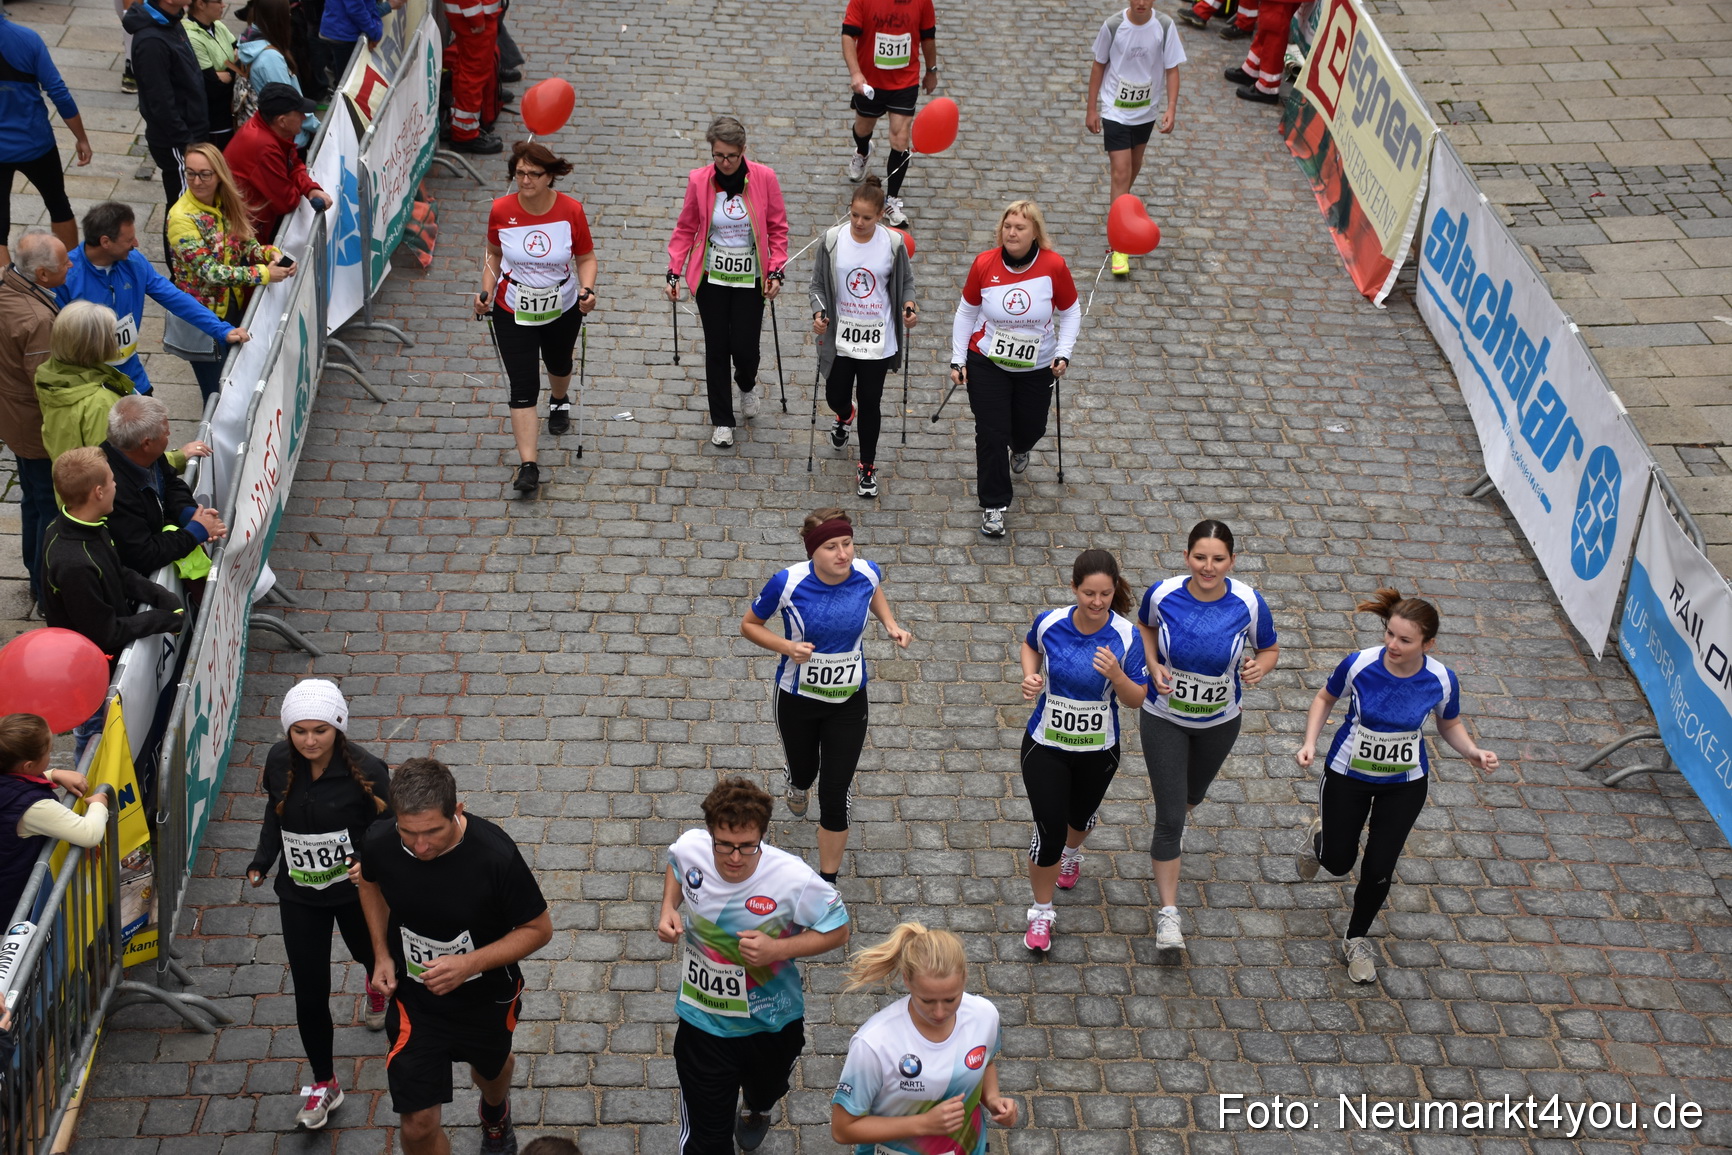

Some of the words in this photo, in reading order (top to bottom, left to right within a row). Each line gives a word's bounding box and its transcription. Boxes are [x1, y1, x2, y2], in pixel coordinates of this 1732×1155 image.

[878, 42, 908, 56] 5311
[1119, 87, 1151, 101] 5131
[714, 255, 752, 273] 5050
[720, 273, 744, 283] Carmen
[520, 294, 559, 313] 5177
[841, 327, 881, 345] 4048
[851, 346, 868, 355] Anna
[994, 339, 1036, 360] 5140
[1624, 594, 1650, 634] AUF
[1645, 630, 1675, 690] JEDER
[806, 657, 825, 666] ARTL
[824, 656, 853, 666] Neumarkt
[806, 663, 857, 685] 5027
[1171, 670, 1193, 682] PARTL
[1193, 676, 1224, 687] Neumarkt
[812, 686, 848, 698] Christine
[1174, 680, 1228, 703] 5142
[1047, 698, 1068, 710] PARTL
[1067, 702, 1099, 712] Neumarkt
[1184, 704, 1214, 714] Sophie
[1051, 708, 1104, 732] 5059
[1056, 733, 1094, 745] Franziska
[1357, 729, 1378, 742] PARTL
[1378, 735, 1410, 744] Neumarkt
[1359, 739, 1413, 763] 5046
[1371, 763, 1396, 774] Sonja
[283, 835, 303, 847] PARTL
[302, 838, 338, 848] Neumarkt
[290, 844, 348, 869] 5184
[302, 867, 343, 884] Charlotte
[749, 899, 774, 911] Hervis
[402, 931, 424, 946] PARTL
[423, 942, 461, 954] Neumarkt
[685, 946, 703, 965] PARTL
[687, 959, 741, 998] 5049
[696, 991, 729, 1009] Manuel
[899, 1080, 926, 1089] PARTL
